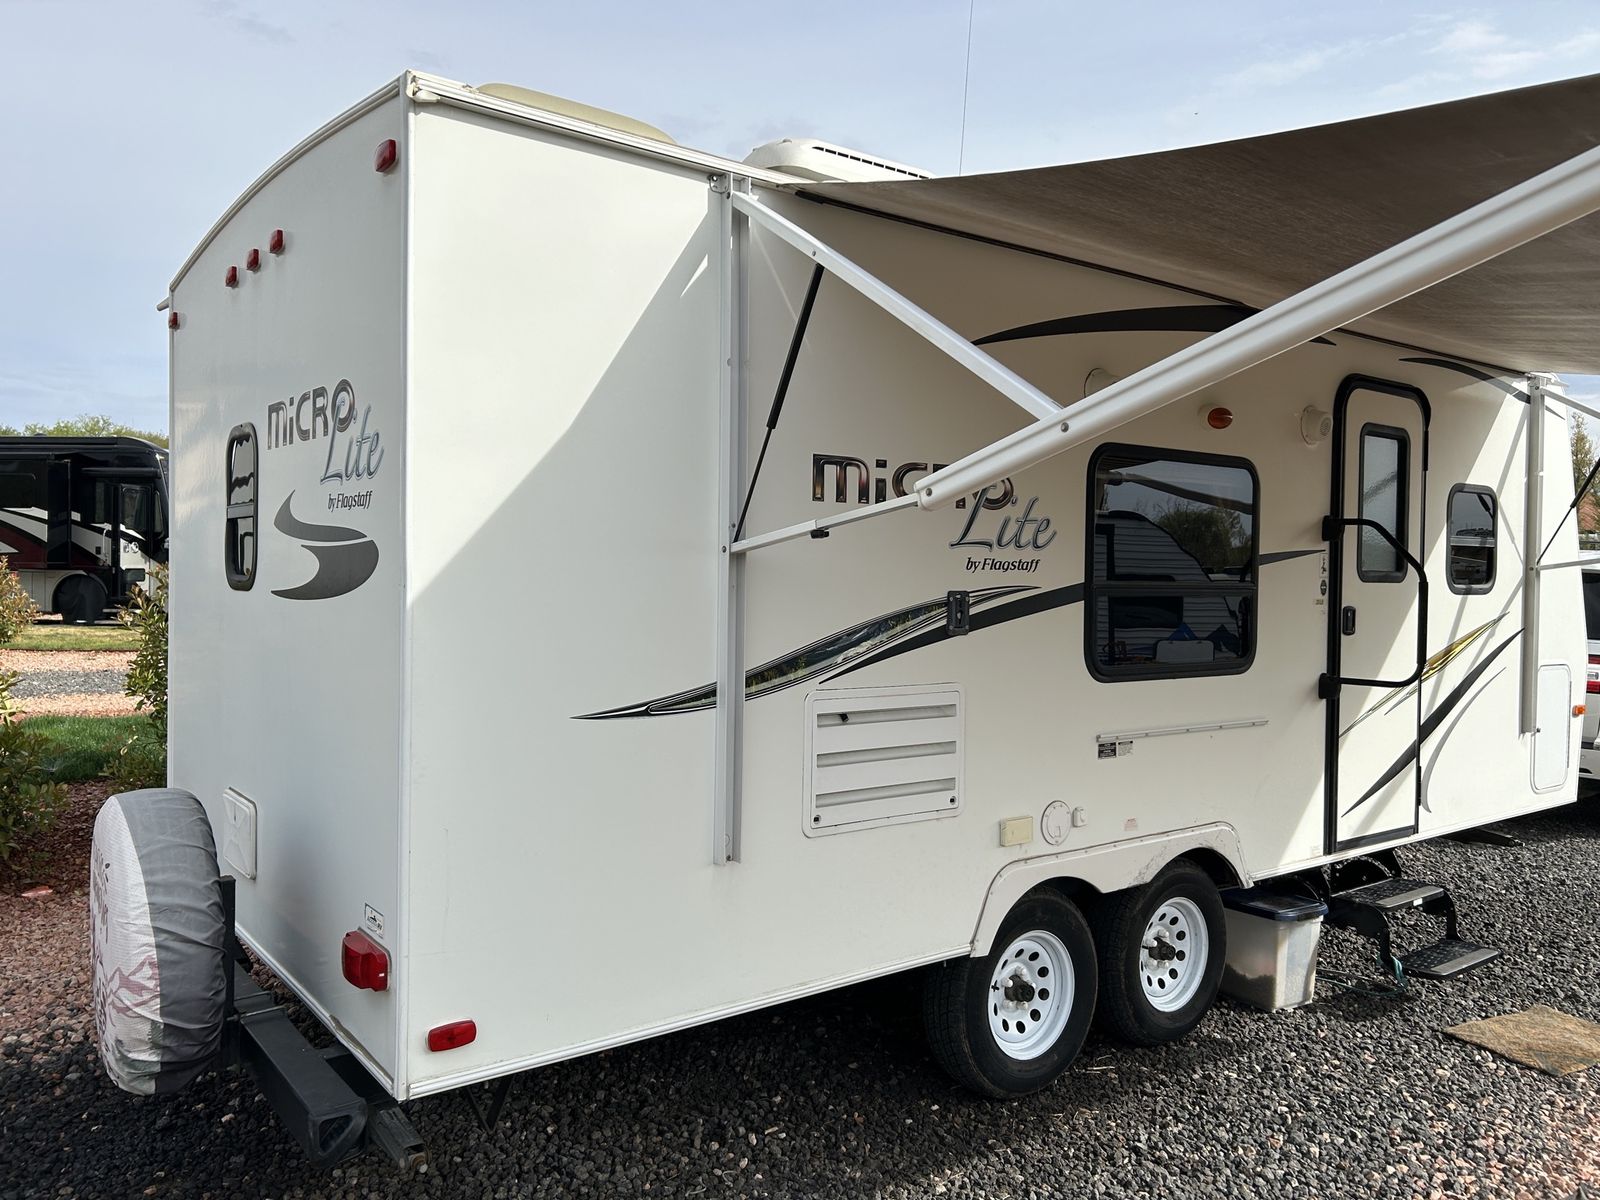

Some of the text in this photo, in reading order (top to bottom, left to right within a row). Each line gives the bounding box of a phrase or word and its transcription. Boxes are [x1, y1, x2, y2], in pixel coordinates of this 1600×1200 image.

[320, 399, 384, 485] Lite
[328, 490, 373, 512] by Flagstaff
[949, 483, 1057, 552] Lite
[966, 556, 1041, 574] by Flagstaff
